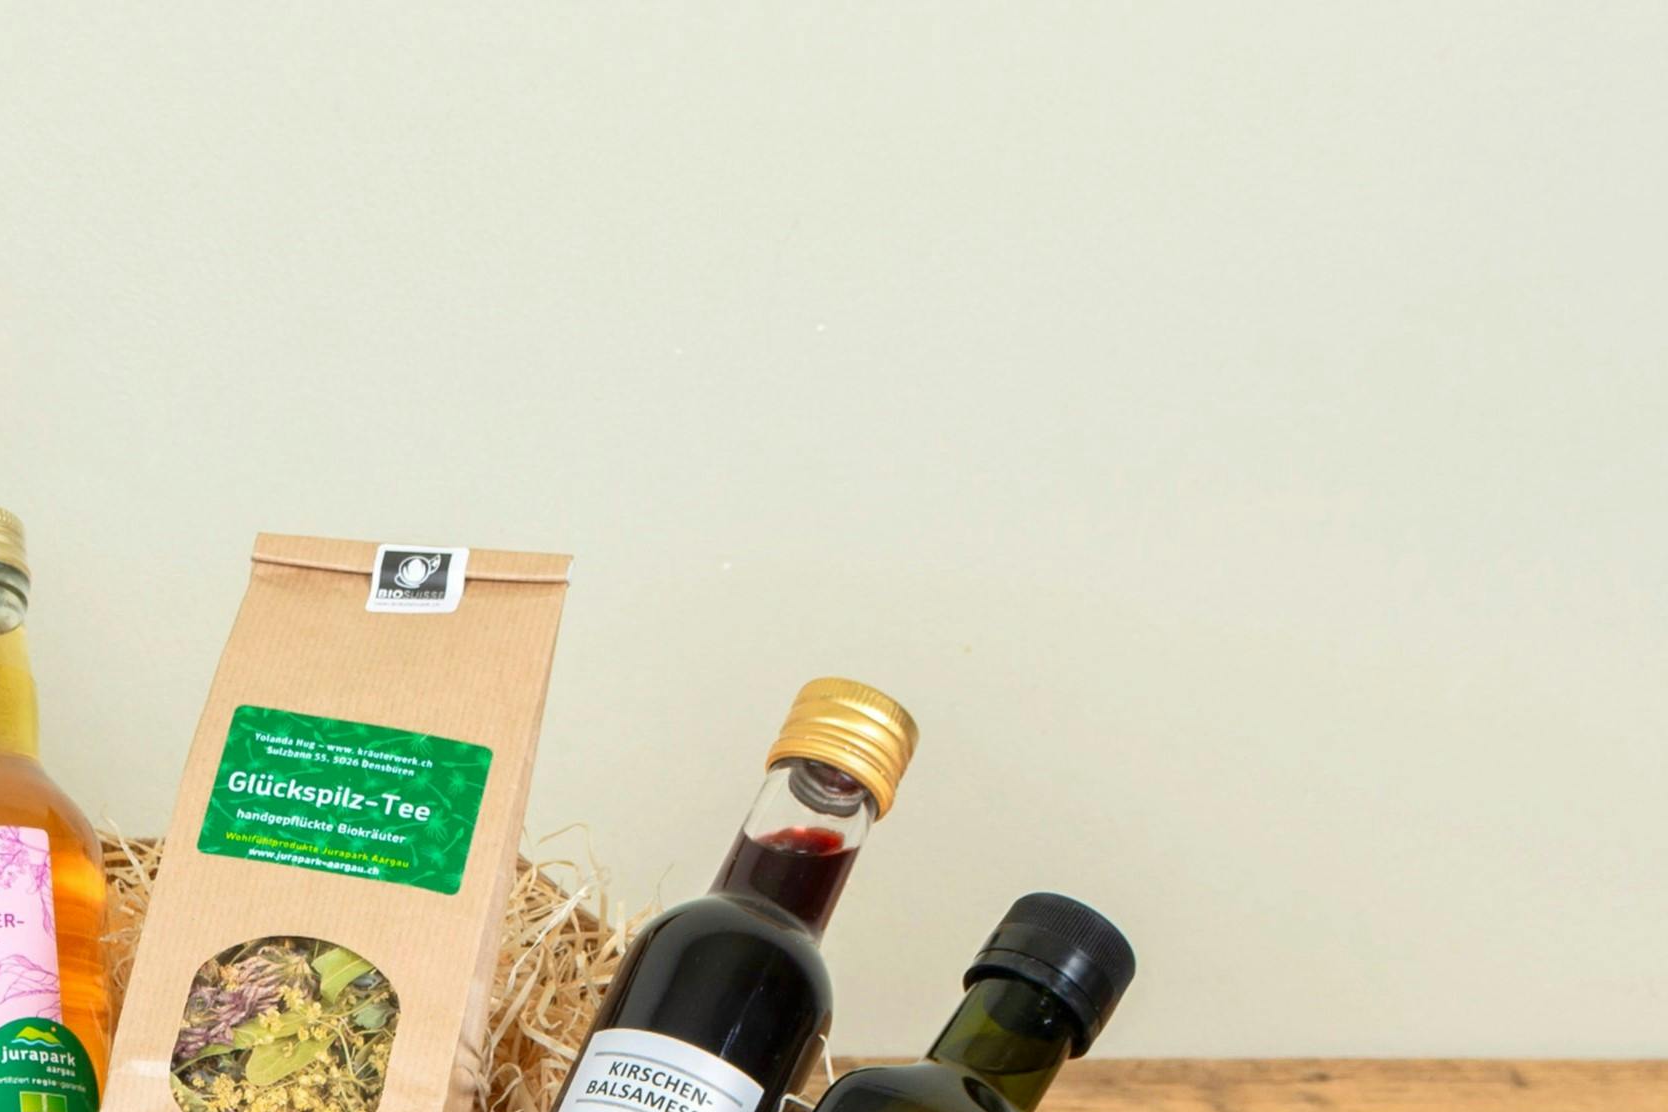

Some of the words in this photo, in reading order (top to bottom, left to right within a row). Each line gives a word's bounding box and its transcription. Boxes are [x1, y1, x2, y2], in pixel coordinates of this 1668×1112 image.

[255, 732, 293, 746] Yolanda
[296, 738, 315, 750] Hug
[357, 748, 432, 769] kräuterwerk.ch
[267, 746, 311, 760] Sulzbann
[333, 756, 359, 767] 5026
[362, 759, 415, 776] Densbüren
[228, 771, 431, 822] Glückspilz-Tee
[236, 808, 333, 832] handgepflückte
[338, 822, 407, 844] Biokräuter
[225, 831, 319, 853] Wohlfühlprodukte
[322, 844, 368, 861] Jurapark
[371, 855, 410, 868] Aargau
[248, 847, 379, 876] www.jurapark-aargau.ch
[1, 1045, 76, 1067] jurapark
[46, 1065, 76, 1077] aargau
[608, 1061, 714, 1107] KIRSCHEN-
